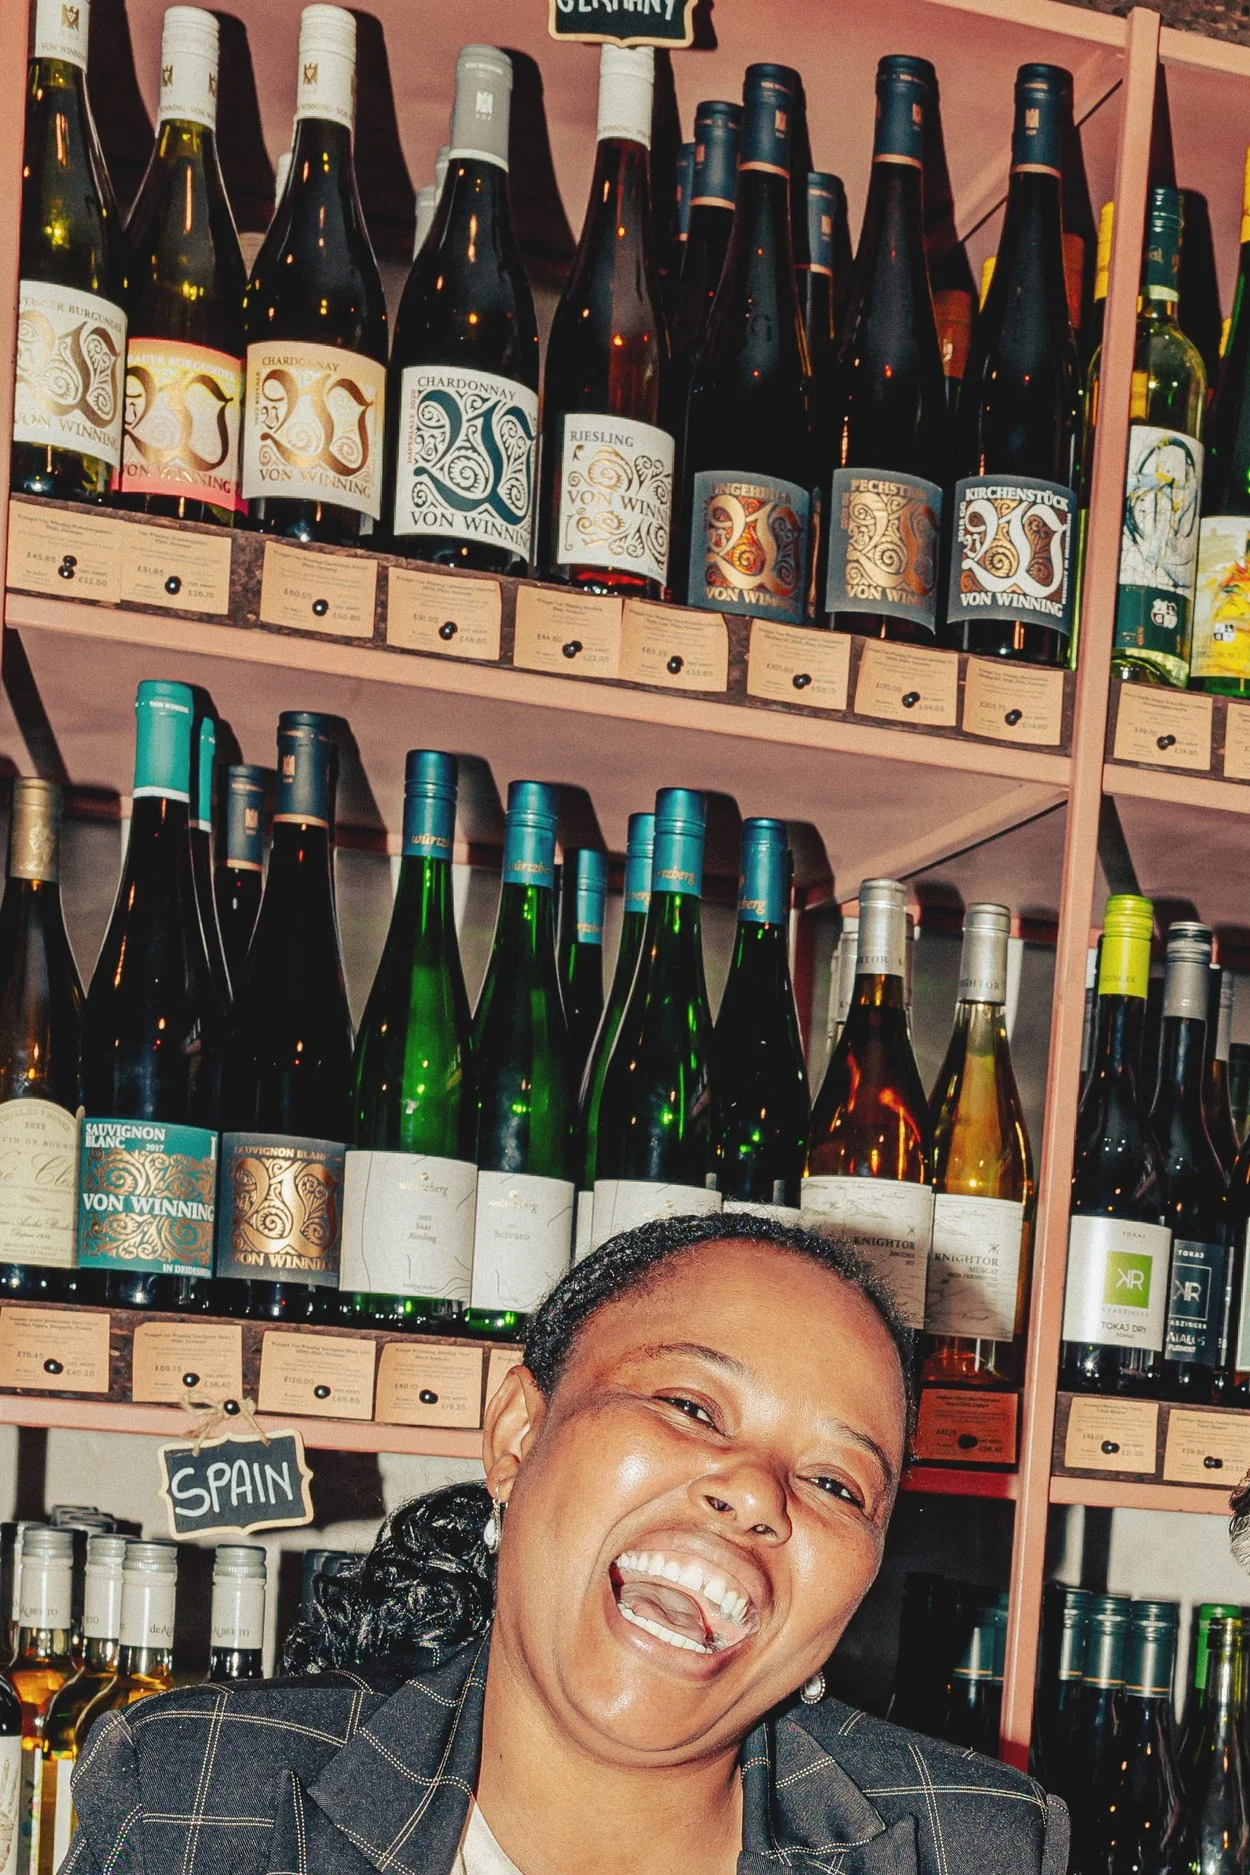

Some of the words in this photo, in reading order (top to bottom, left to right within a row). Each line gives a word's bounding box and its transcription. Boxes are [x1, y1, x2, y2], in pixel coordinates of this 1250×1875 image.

[261, 355, 340, 373] CHARDONNAY
[417, 376, 517, 401] CHARDONNAY
[570, 430, 635, 448] RIESLING
[259, 468, 292, 482] VON
[299, 470, 371, 499] WINNING
[567, 489, 613, 509] VON
[965, 486, 1070, 512] KIRCHENSTÜCK
[410, 510, 454, 528] VON
[706, 585, 740, 602] VON
[845, 584, 881, 601] VON
[960, 591, 994, 607] VON
[995, 592, 1064, 618] WINNING
[85, 1122, 166, 1142] SAUVIGNON
[84, 1135, 126, 1150] BLANC
[145, 1143, 165, 1152] 2017
[83, 1192, 123, 1213] VON
[130, 1196, 215, 1223] WINNING
[408, 1232, 437, 1244] Riesling
[854, 1236, 916, 1250] KNIGHTOR
[1122, 1231, 1147, 1239] TOKAJ
[934, 1252, 999, 1267] KNIGHTOR
[1177, 1249, 1205, 1259] TOKAJ
[162, 1263, 173, 1273] IN
[1101, 1320, 1130, 1333] TOKAJ
[1131, 1323, 1147, 1334] DRY
[1168, 1319, 1208, 1330] ASZINGER
[172, 1460, 293, 1517] SPAIN
